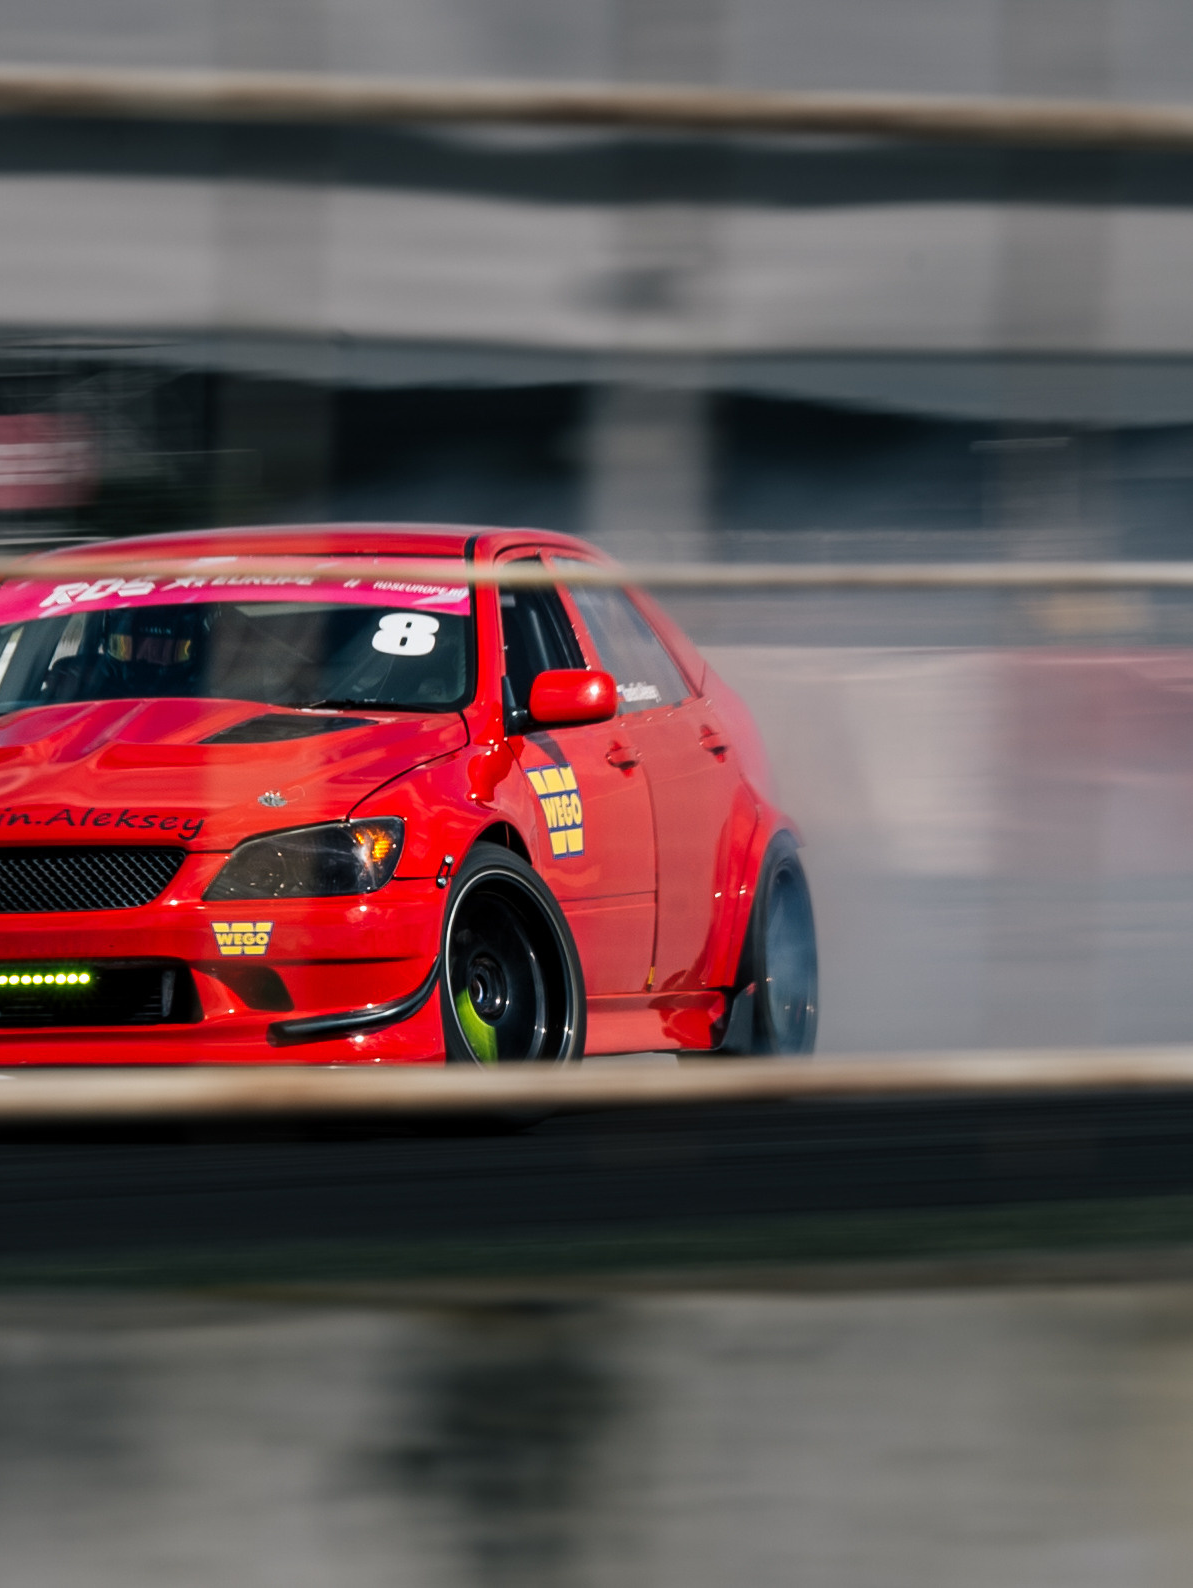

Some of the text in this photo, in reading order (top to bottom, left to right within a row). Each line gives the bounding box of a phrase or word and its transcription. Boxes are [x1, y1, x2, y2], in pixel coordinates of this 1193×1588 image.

[39, 577, 155, 608] RDS
[371, 612, 439, 656] 8
[540, 793, 583, 828] WEGO
[215, 932, 270, 946] WEGO
